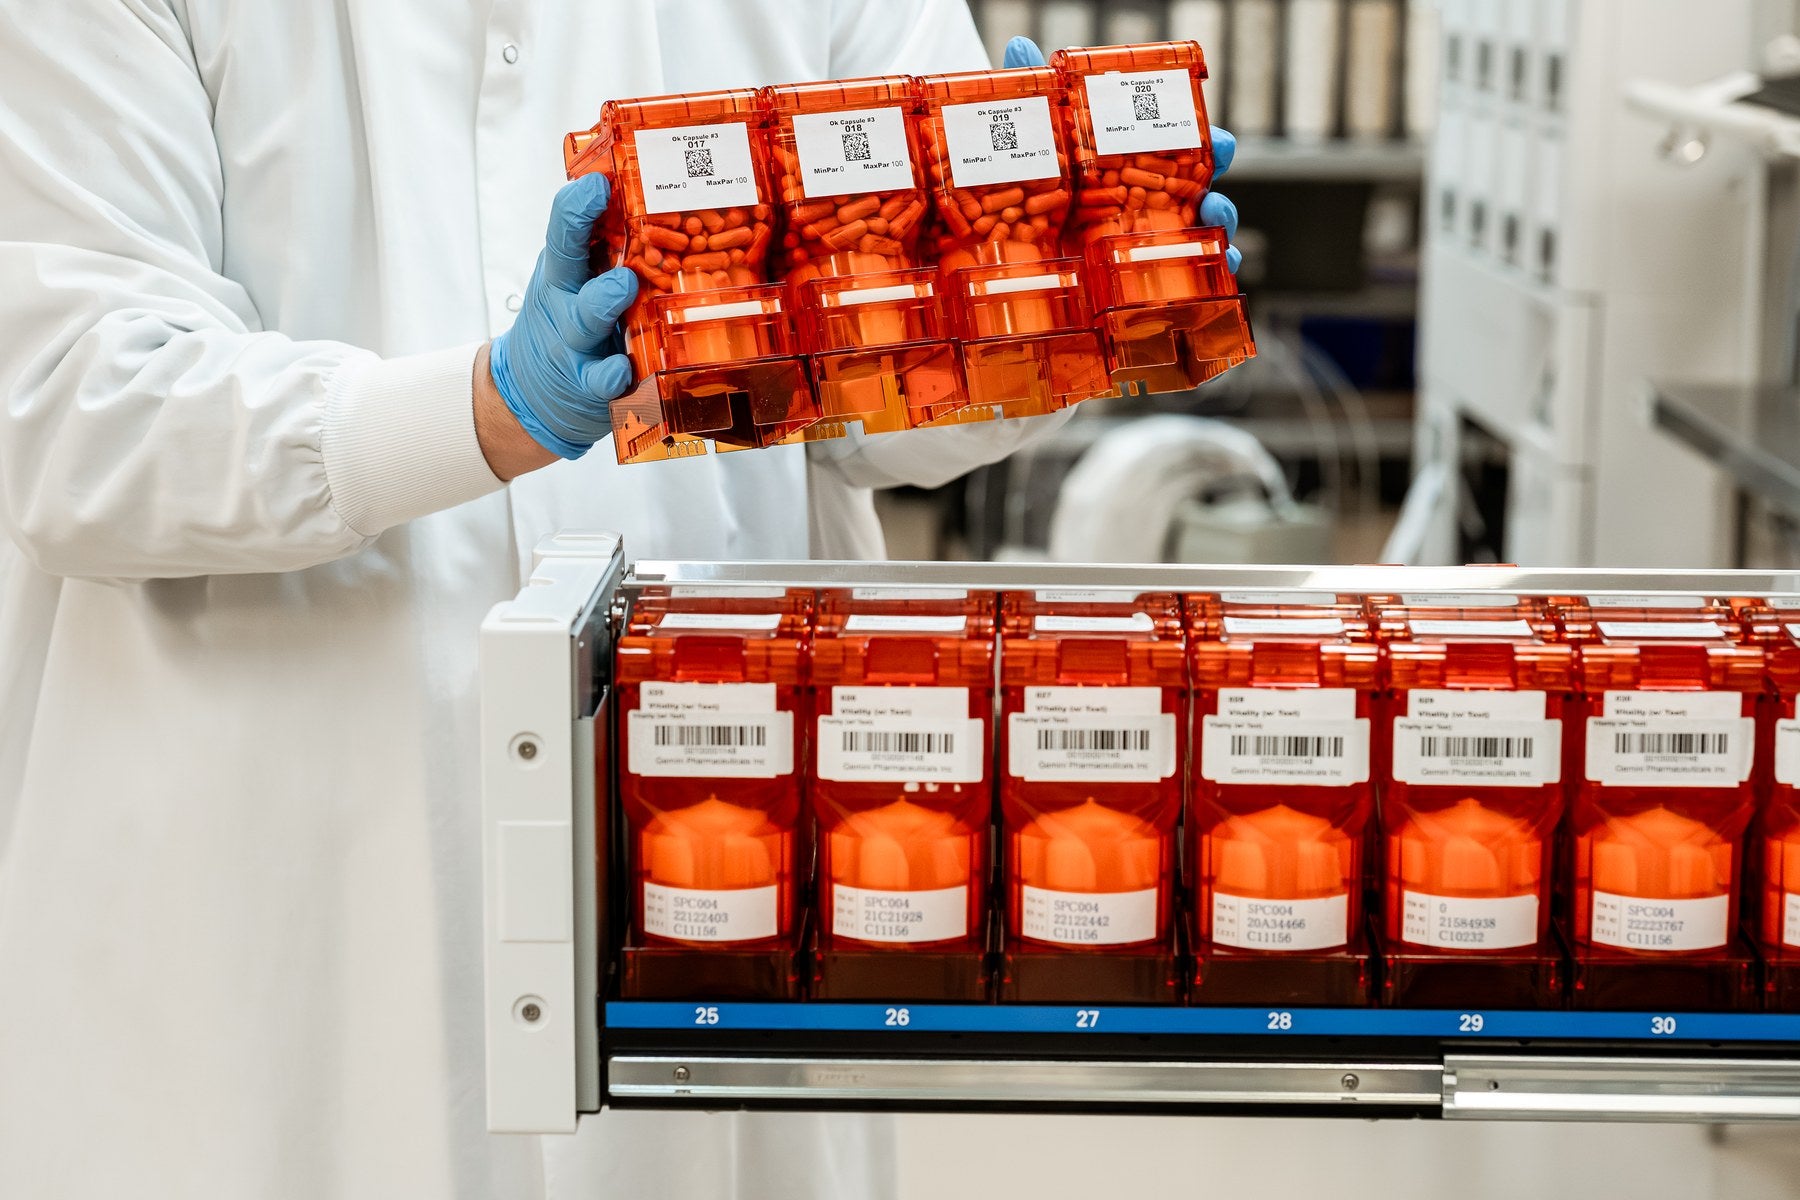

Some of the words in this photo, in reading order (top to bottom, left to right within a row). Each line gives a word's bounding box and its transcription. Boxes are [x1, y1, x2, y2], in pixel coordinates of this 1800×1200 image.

[1130, 79, 1151, 87] Capsule
[1135, 85, 1152, 93] 020
[988, 108, 1012, 116] Capsule
[992, 114, 1010, 122] 019
[840, 118, 862, 126] Capsule
[845, 125, 862, 133] 018
[683, 134, 708, 143] Capsule
[687, 140, 704, 148] 017
[1010, 151, 1036, 159] MaxPar
[673, 896, 718, 910] SPC004
[864, 896, 909, 910] SPC004
[1053, 900, 1099, 914] SPC004
[1247, 903, 1293, 916] SPC004
[673, 910, 729, 924] 22122403
[864, 910, 923, 923] 21C21928
[1627, 904, 1675, 918] SPC004
[1053, 914, 1110, 927] 22122442
[1247, 916, 1306, 930] 20A34466
[1439, 916, 1496, 929] 21584938
[1627, 918, 1684, 932] 22223767
[673, 923, 718, 937] C11156
[864, 923, 909, 936] C11156
[1053, 927, 1098, 940] C11156
[1246, 930, 1292, 943] C11156
[1438, 930, 1485, 943] C10232
[1626, 932, 1673, 945] C11156
[695, 1007, 719, 1025] 25
[885, 1008, 909, 1026] 26
[1076, 1011, 1099, 1028] 27
[1268, 1012, 1292, 1030] 28
[1459, 1014, 1483, 1032] 29
[1651, 1017, 1676, 1035] 30
